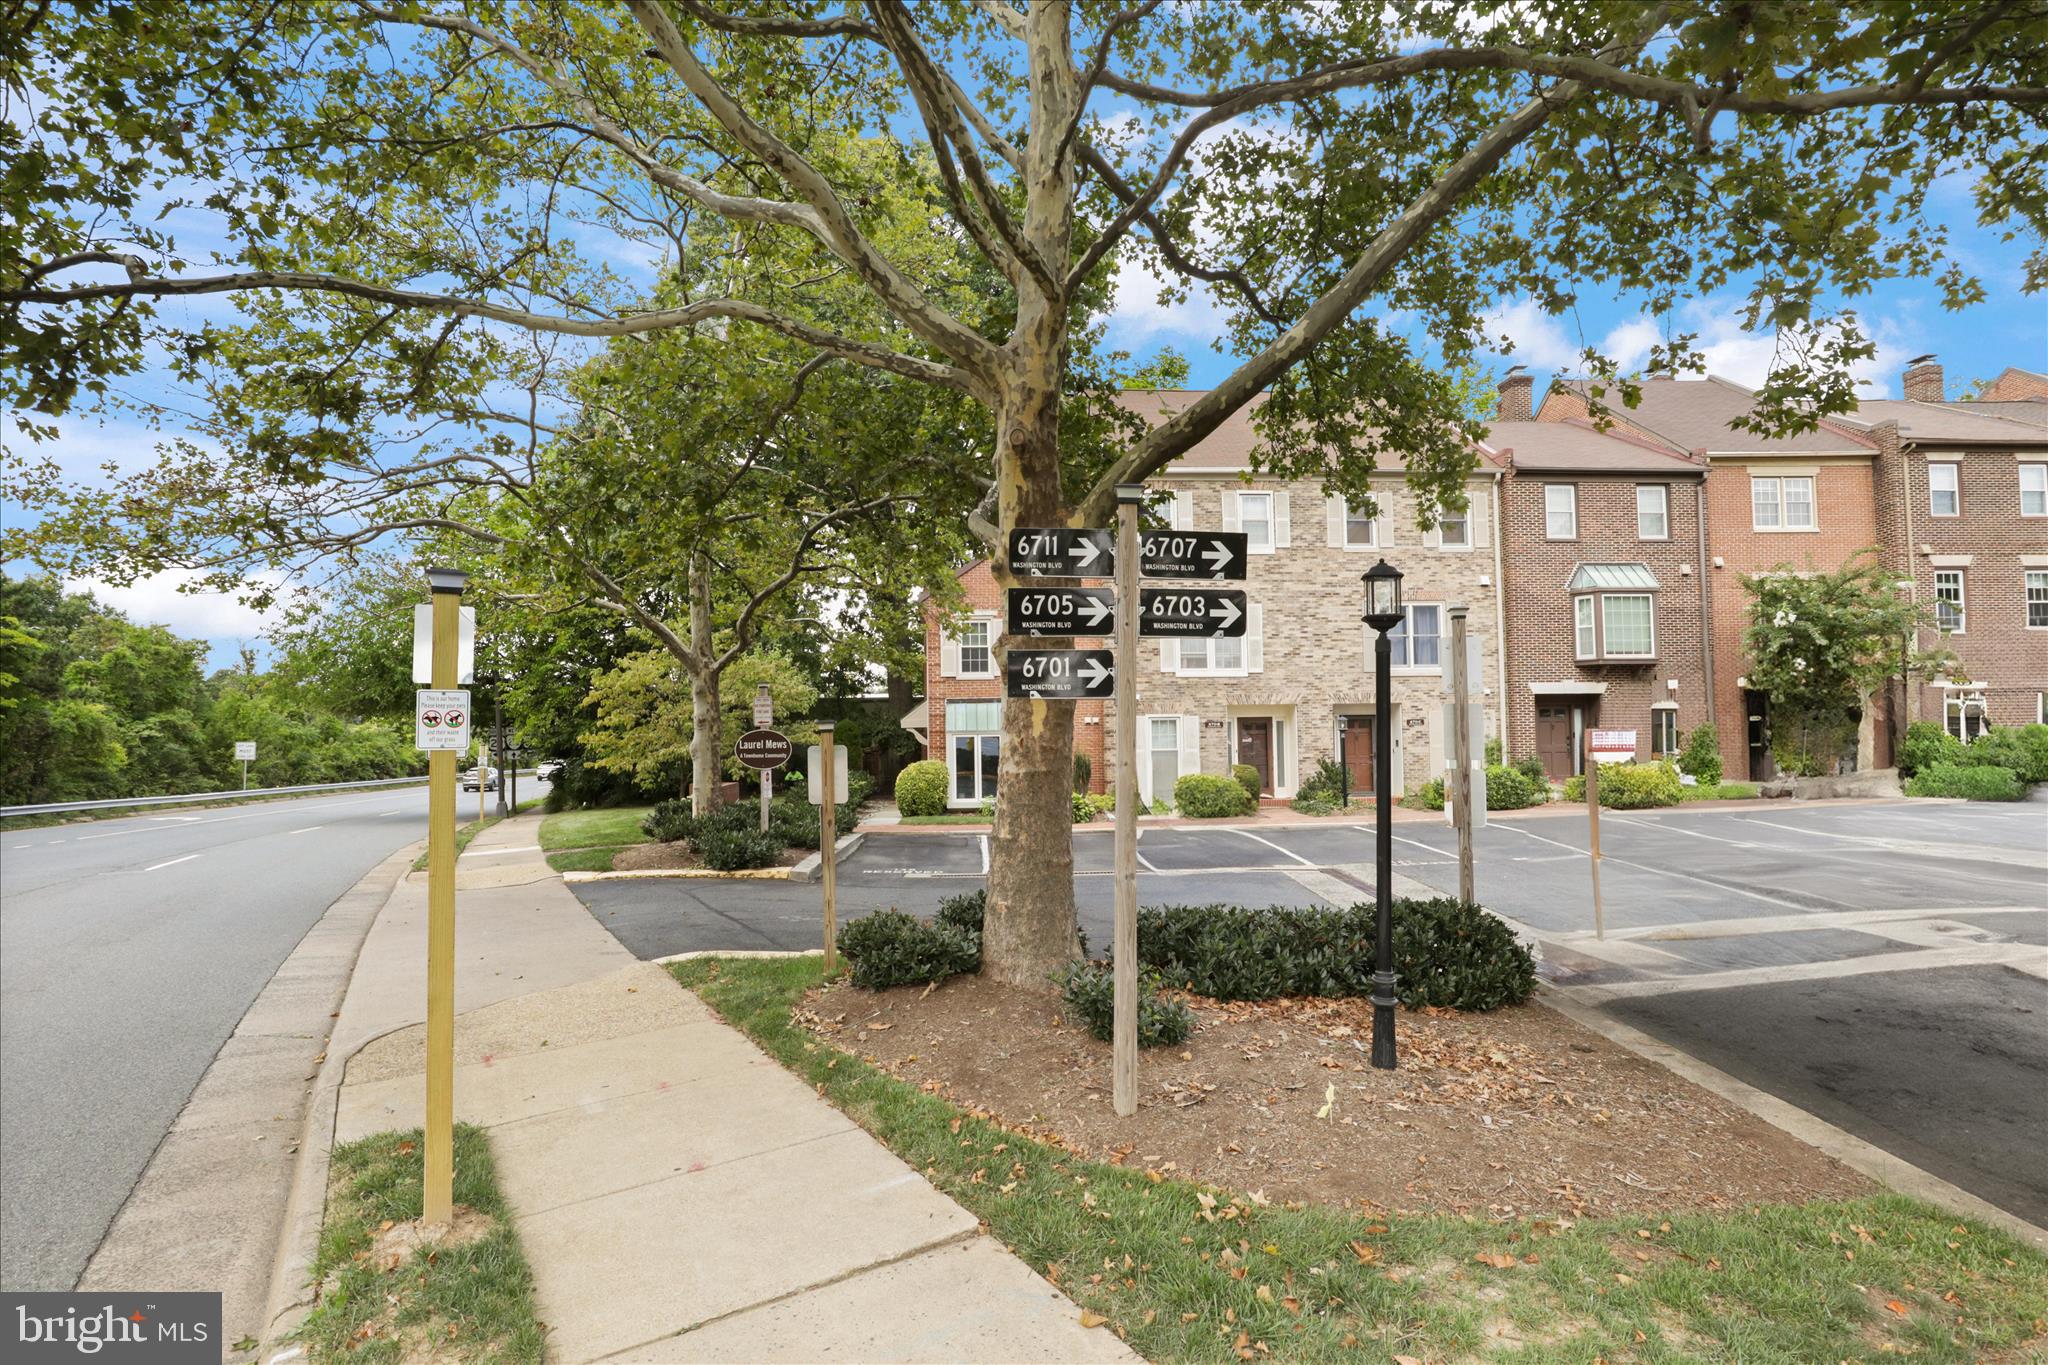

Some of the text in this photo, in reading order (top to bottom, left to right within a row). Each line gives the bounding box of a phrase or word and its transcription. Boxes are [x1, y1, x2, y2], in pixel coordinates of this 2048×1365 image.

[1017, 535, 1058, 556] 6711
[1145, 537, 1197, 558] 6707
[1020, 595, 1074, 616] 6705
[1152, 596, 1205, 617] 6703
[1153, 622, 1188, 630] WASHINGTON
[1022, 656, 1070, 678] 6701
[1021, 683, 1072, 691] WASHINGTON BLVD
[740, 740, 787, 749] Laurel Mews
